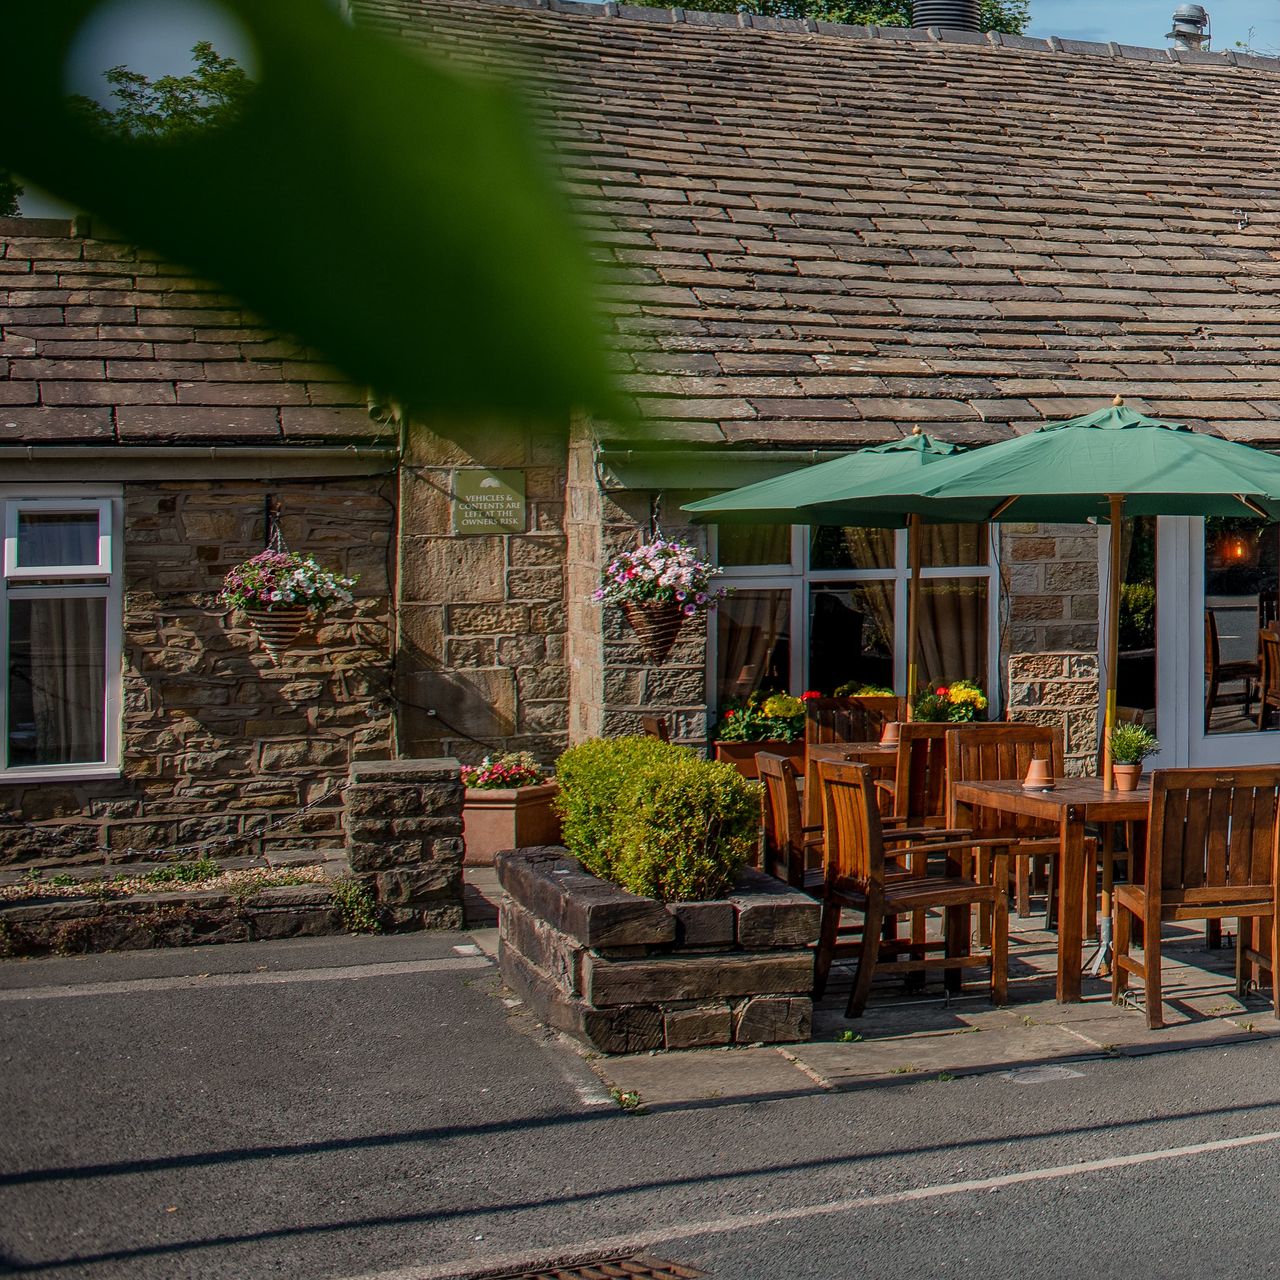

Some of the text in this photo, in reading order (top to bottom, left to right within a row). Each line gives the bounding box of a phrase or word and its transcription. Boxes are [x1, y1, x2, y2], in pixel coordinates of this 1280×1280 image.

[465, 494, 505, 502] VEHICLES
[459, 502, 504, 510] CONTENTS
[500, 517, 519, 525] RISK
